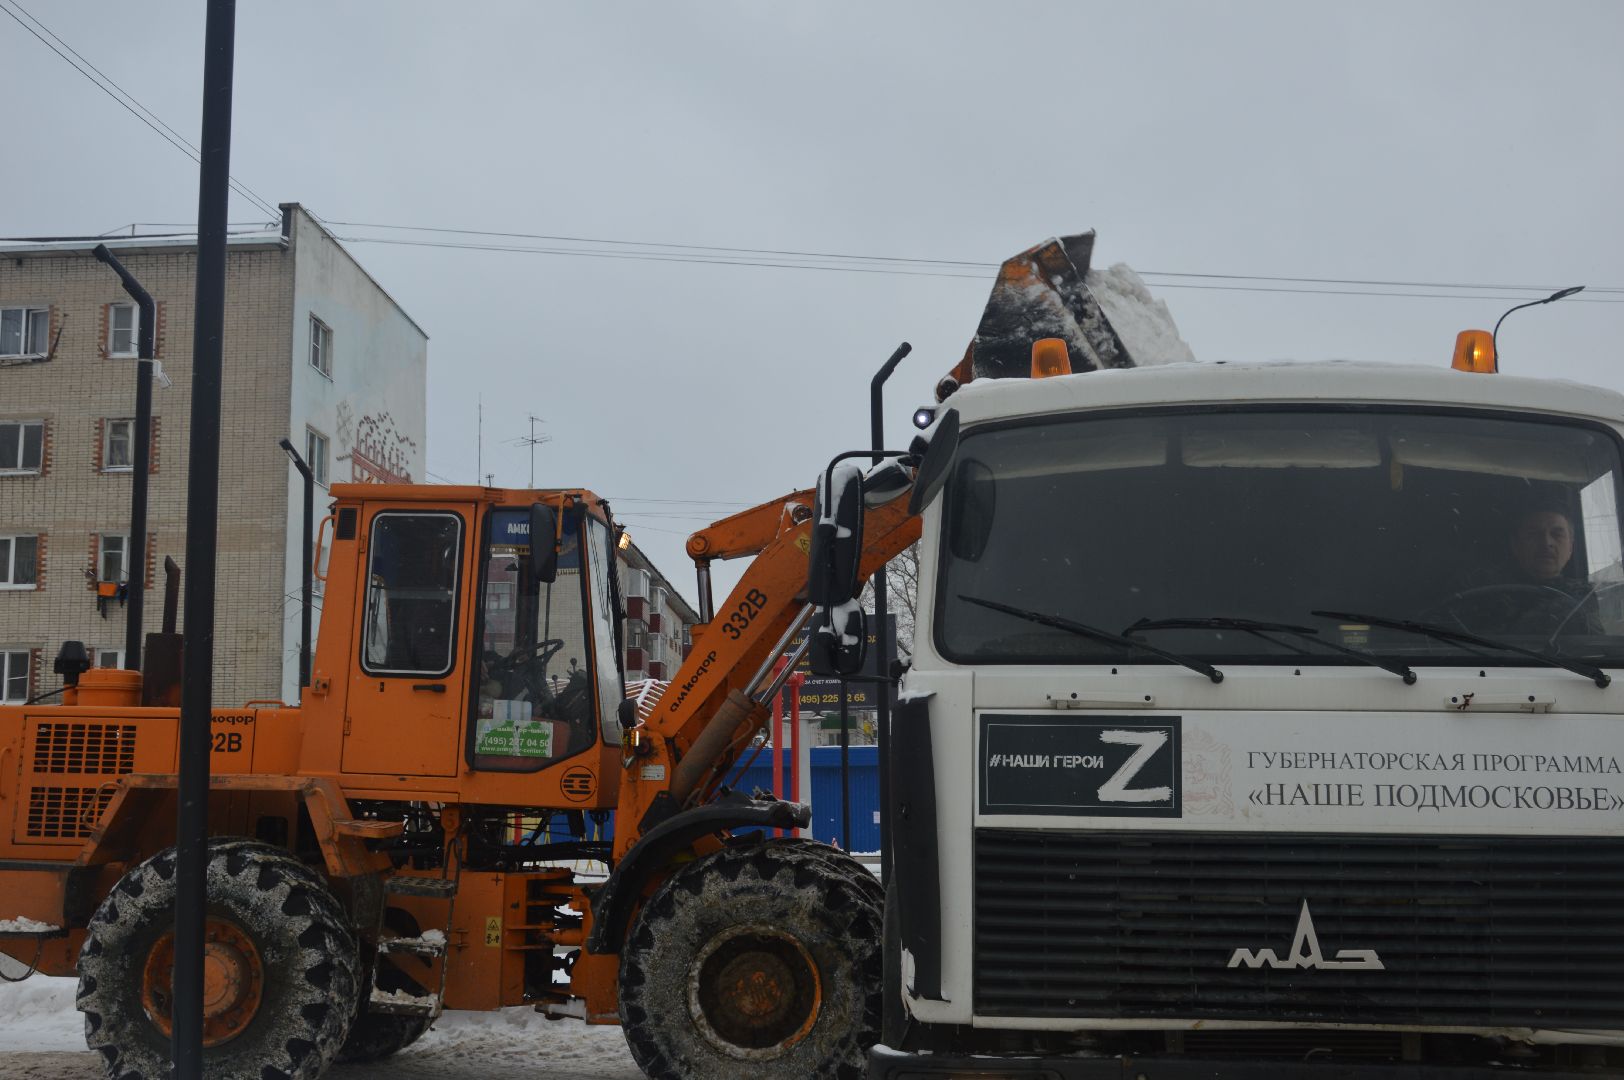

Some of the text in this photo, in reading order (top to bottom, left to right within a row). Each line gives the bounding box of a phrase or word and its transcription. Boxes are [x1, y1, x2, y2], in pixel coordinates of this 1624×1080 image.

[722, 588, 768, 640] 332В
[799, 694, 820, 705] (495)
[822, 694, 839, 703] 225
[854, 693, 866, 702] 65
[484, 737, 507, 745] (495)
[508, 738, 524, 746] 27
[526, 739, 537, 747] 04
[989, 754, 1104, 769] #НАШИ ГЕРОИ
[1097, 729, 1173, 803] Z
[1247, 751, 1623, 774] ГУБЕРНАТОРСКАЯ ПРОГРАММА
[1248, 782, 1624, 813] «НАШЕ ПОДМОСКОВЬЕ»
